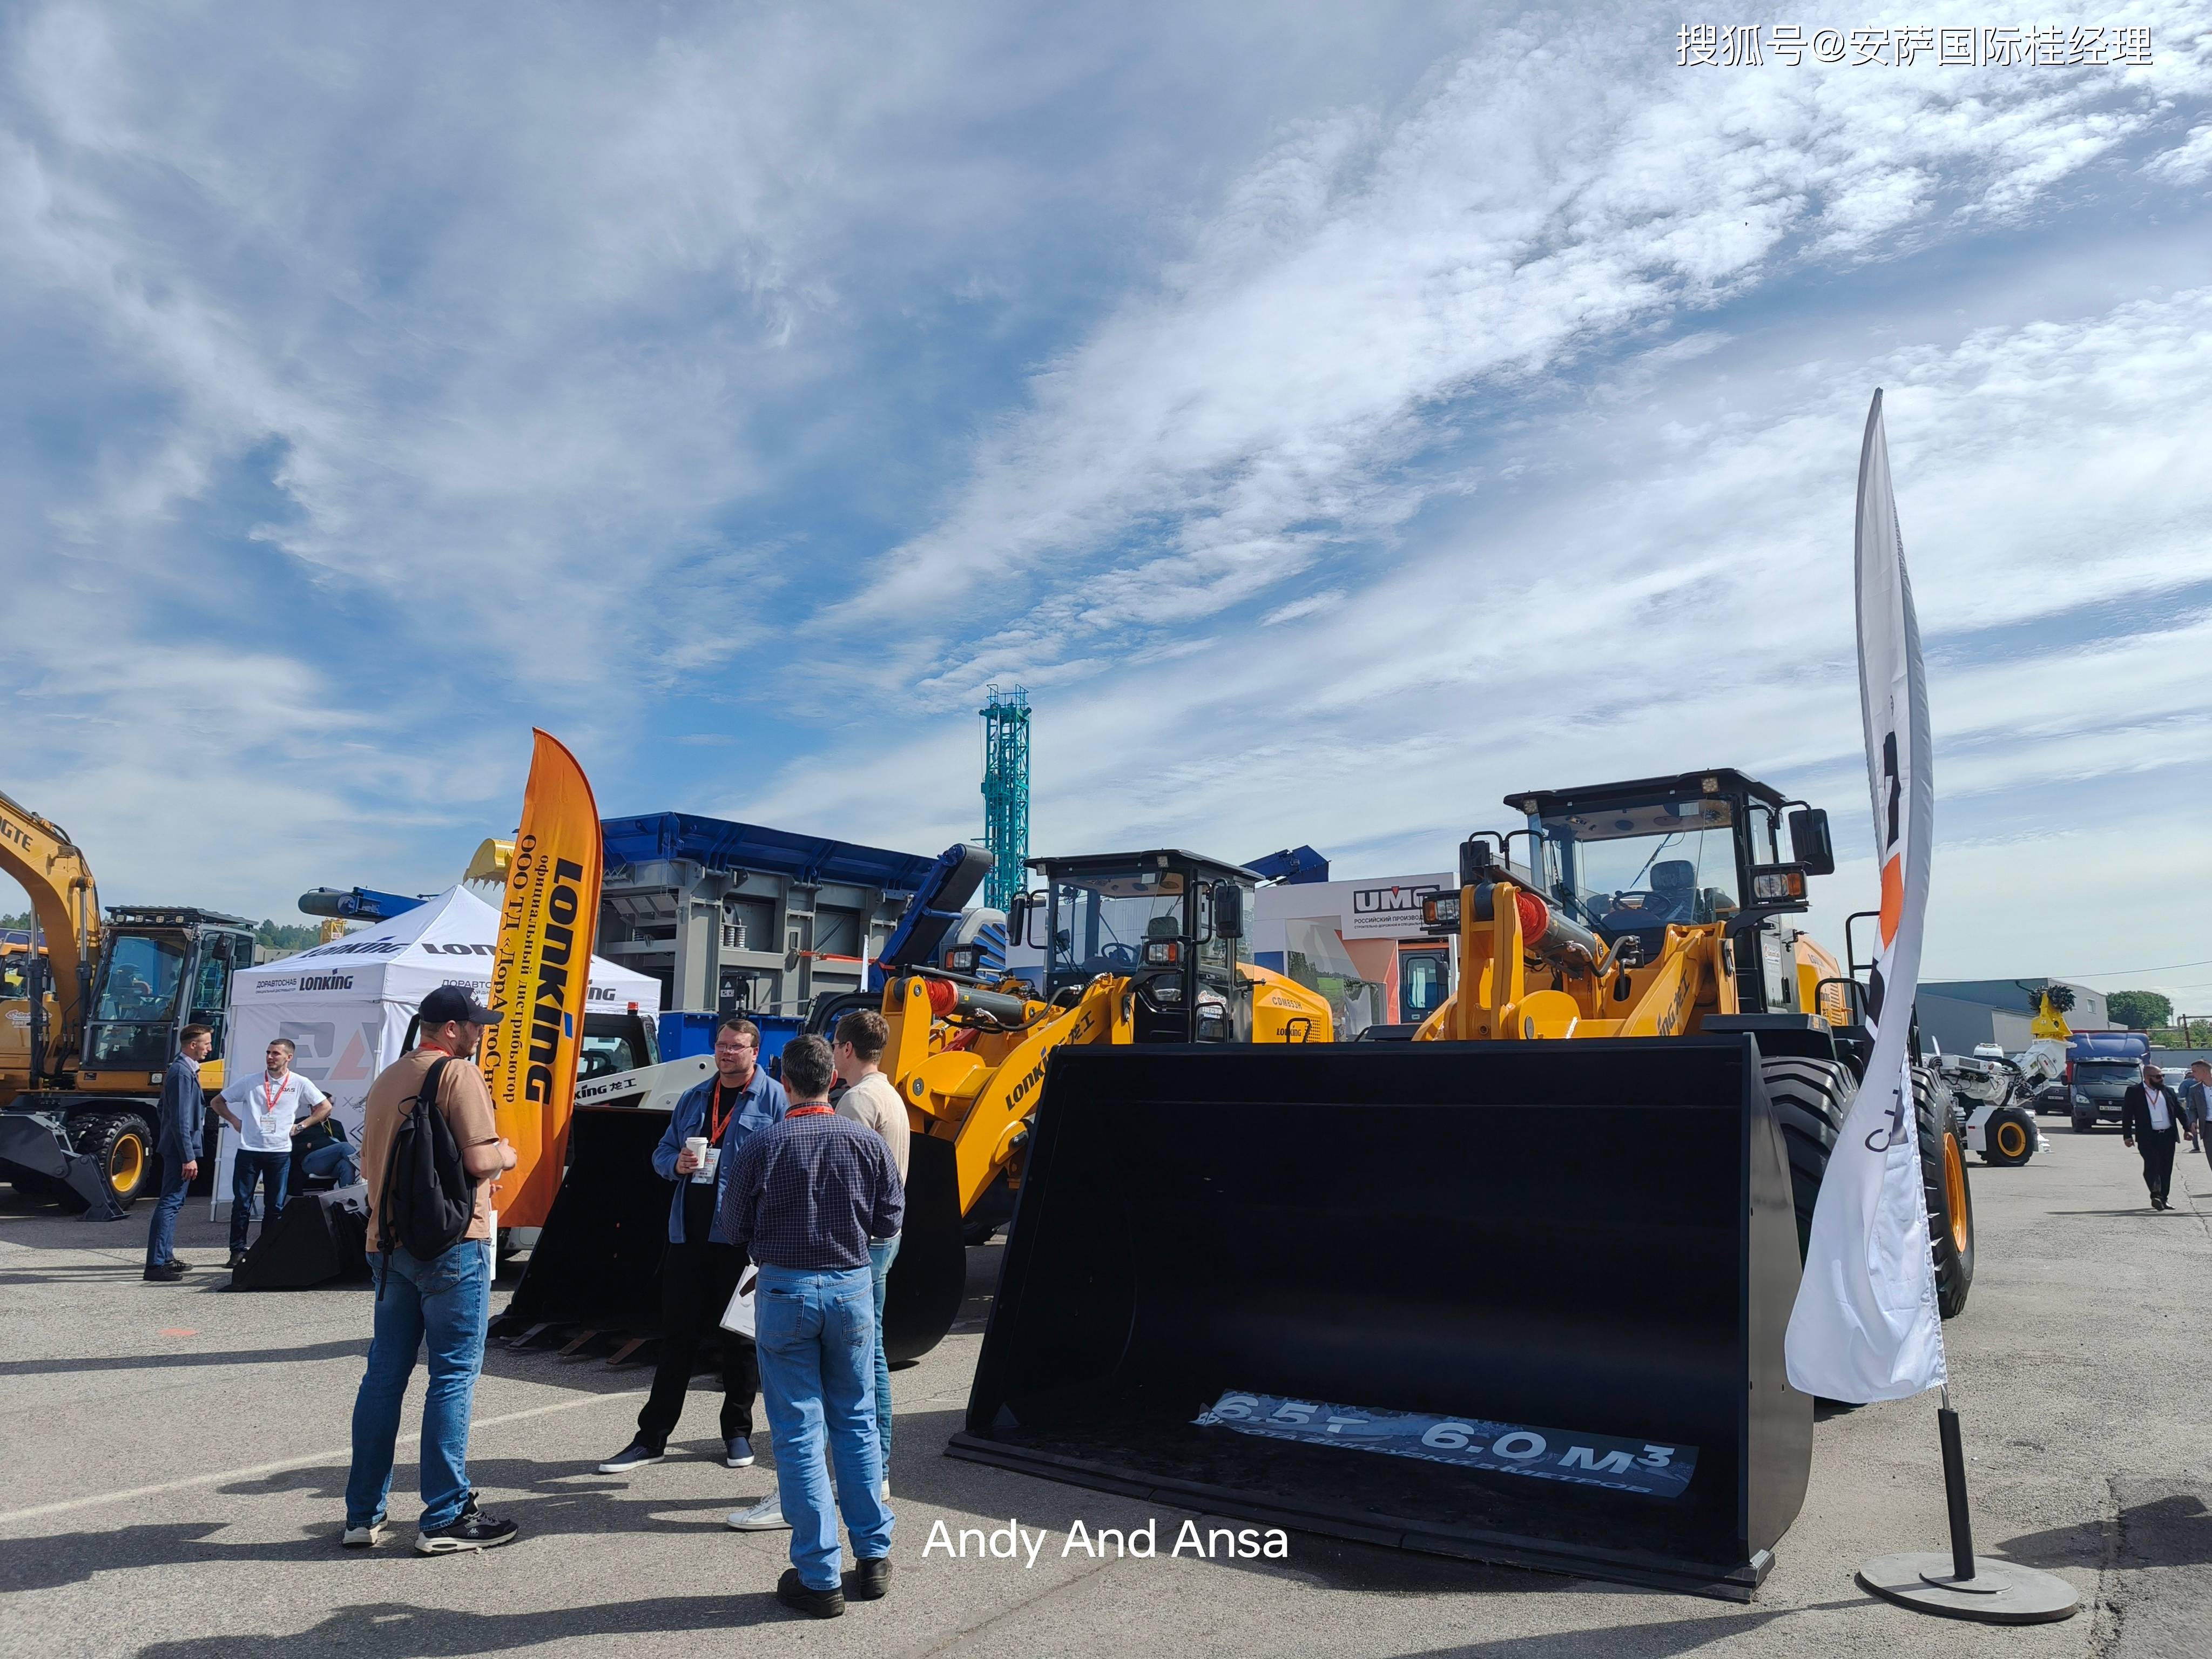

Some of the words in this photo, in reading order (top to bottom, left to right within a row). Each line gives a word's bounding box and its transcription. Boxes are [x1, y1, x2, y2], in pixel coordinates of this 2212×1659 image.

[0, 816, 33, 852] GTE
[513, 834, 536, 889] ООО
[502, 896, 524, 930] ТД
[521, 855, 549, 975] официальный
[1354, 915, 1391, 923] РОССИЙСКИЙ
[256, 979, 297, 989] ДОРАВТОСНАБ
[299, 968, 354, 991] LONKING
[442, 979, 491, 989] ДОРАВТО
[525, 858, 583, 1105] LONKING
[503, 980, 528, 1103] дистрибьютор
[574, 1084, 607, 1100] KING
[1211, 1396, 1319, 1425] 6.5
[1421, 1422, 1547, 1459] 6.0
[1500, 1465, 1654, 1493] МЕТРОВ
